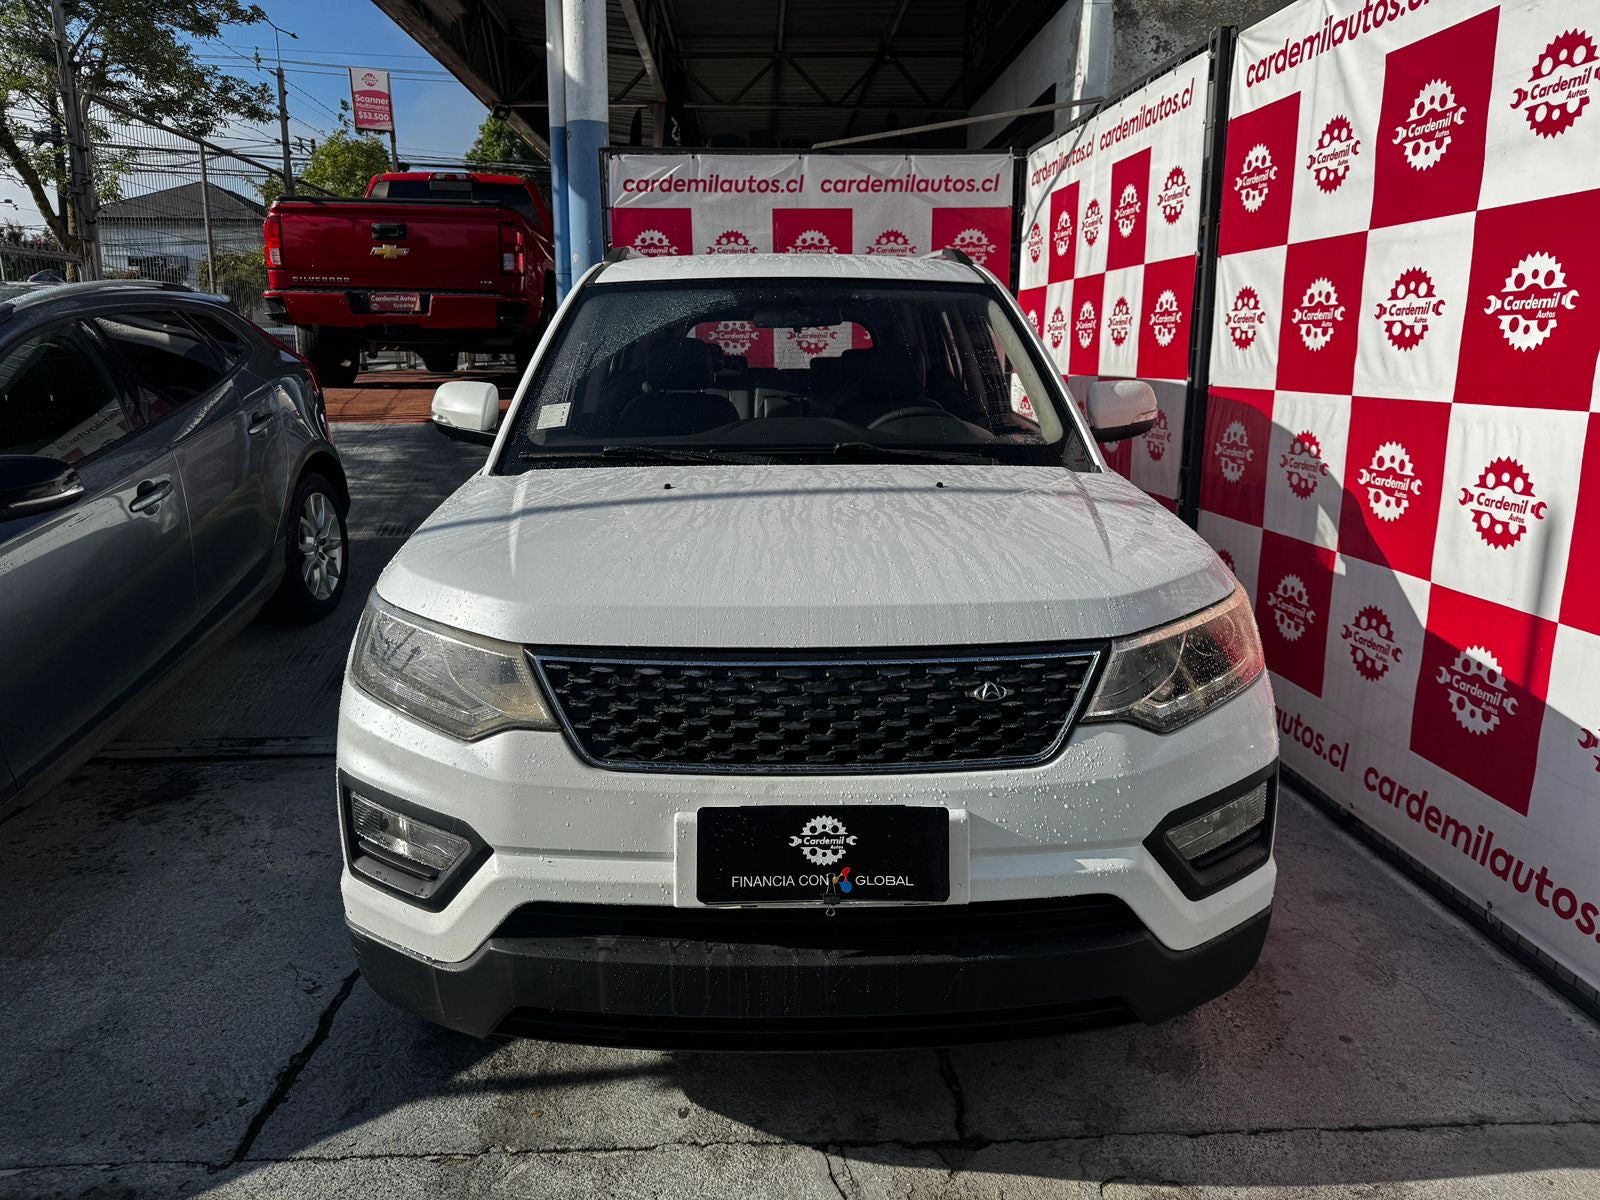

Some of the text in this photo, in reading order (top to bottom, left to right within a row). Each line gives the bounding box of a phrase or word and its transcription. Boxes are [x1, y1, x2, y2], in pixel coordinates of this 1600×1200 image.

[1246, 0, 1429, 88] cardemilautos.
[1530, 66, 1593, 100] Cardemil
[355, 94, 389, 105] Scanner
[1566, 87, 1588, 100] Autos
[358, 111, 389, 121] $53.500
[1100, 77, 1195, 151] cardemilautos.cl
[1408, 111, 1452, 138] Cardemil
[1434, 129, 1450, 139] Autos
[1317, 143, 1351, 164] Cardemil
[622, 174, 805, 193] cardemilautos.cl
[820, 173, 1000, 193] cardemilautos.cl
[1243, 168, 1269, 187] Cardemil
[636, 246, 669, 254] Cardemil
[716, 246, 749, 254] Cardemil
[876, 246, 908, 254] Cardemil
[1503, 292, 1561, 311] Cardemil
[1302, 307, 1335, 320] Cardemil
[1388, 302, 1431, 316] Cardemil
[1536, 310, 1556, 318] Autos
[1232, 312, 1256, 324] Cardemil
[718, 331, 750, 339] Cardemil
[1289, 457, 1320, 472] Cardemil
[1370, 474, 1410, 491] Cardemil
[1476, 492, 1529, 514] Cardemil
[1508, 513, 1525, 523] Autos
[1277, 598, 1306, 618] Cardemil
[1352, 631, 1391, 655] Cardemil
[1452, 675, 1502, 706] Cardemil
[1481, 702, 1498, 715] Autos
[803, 836, 845, 845] Cardemil
[731, 874, 914, 887] FINANCIA CON GLOBAL
